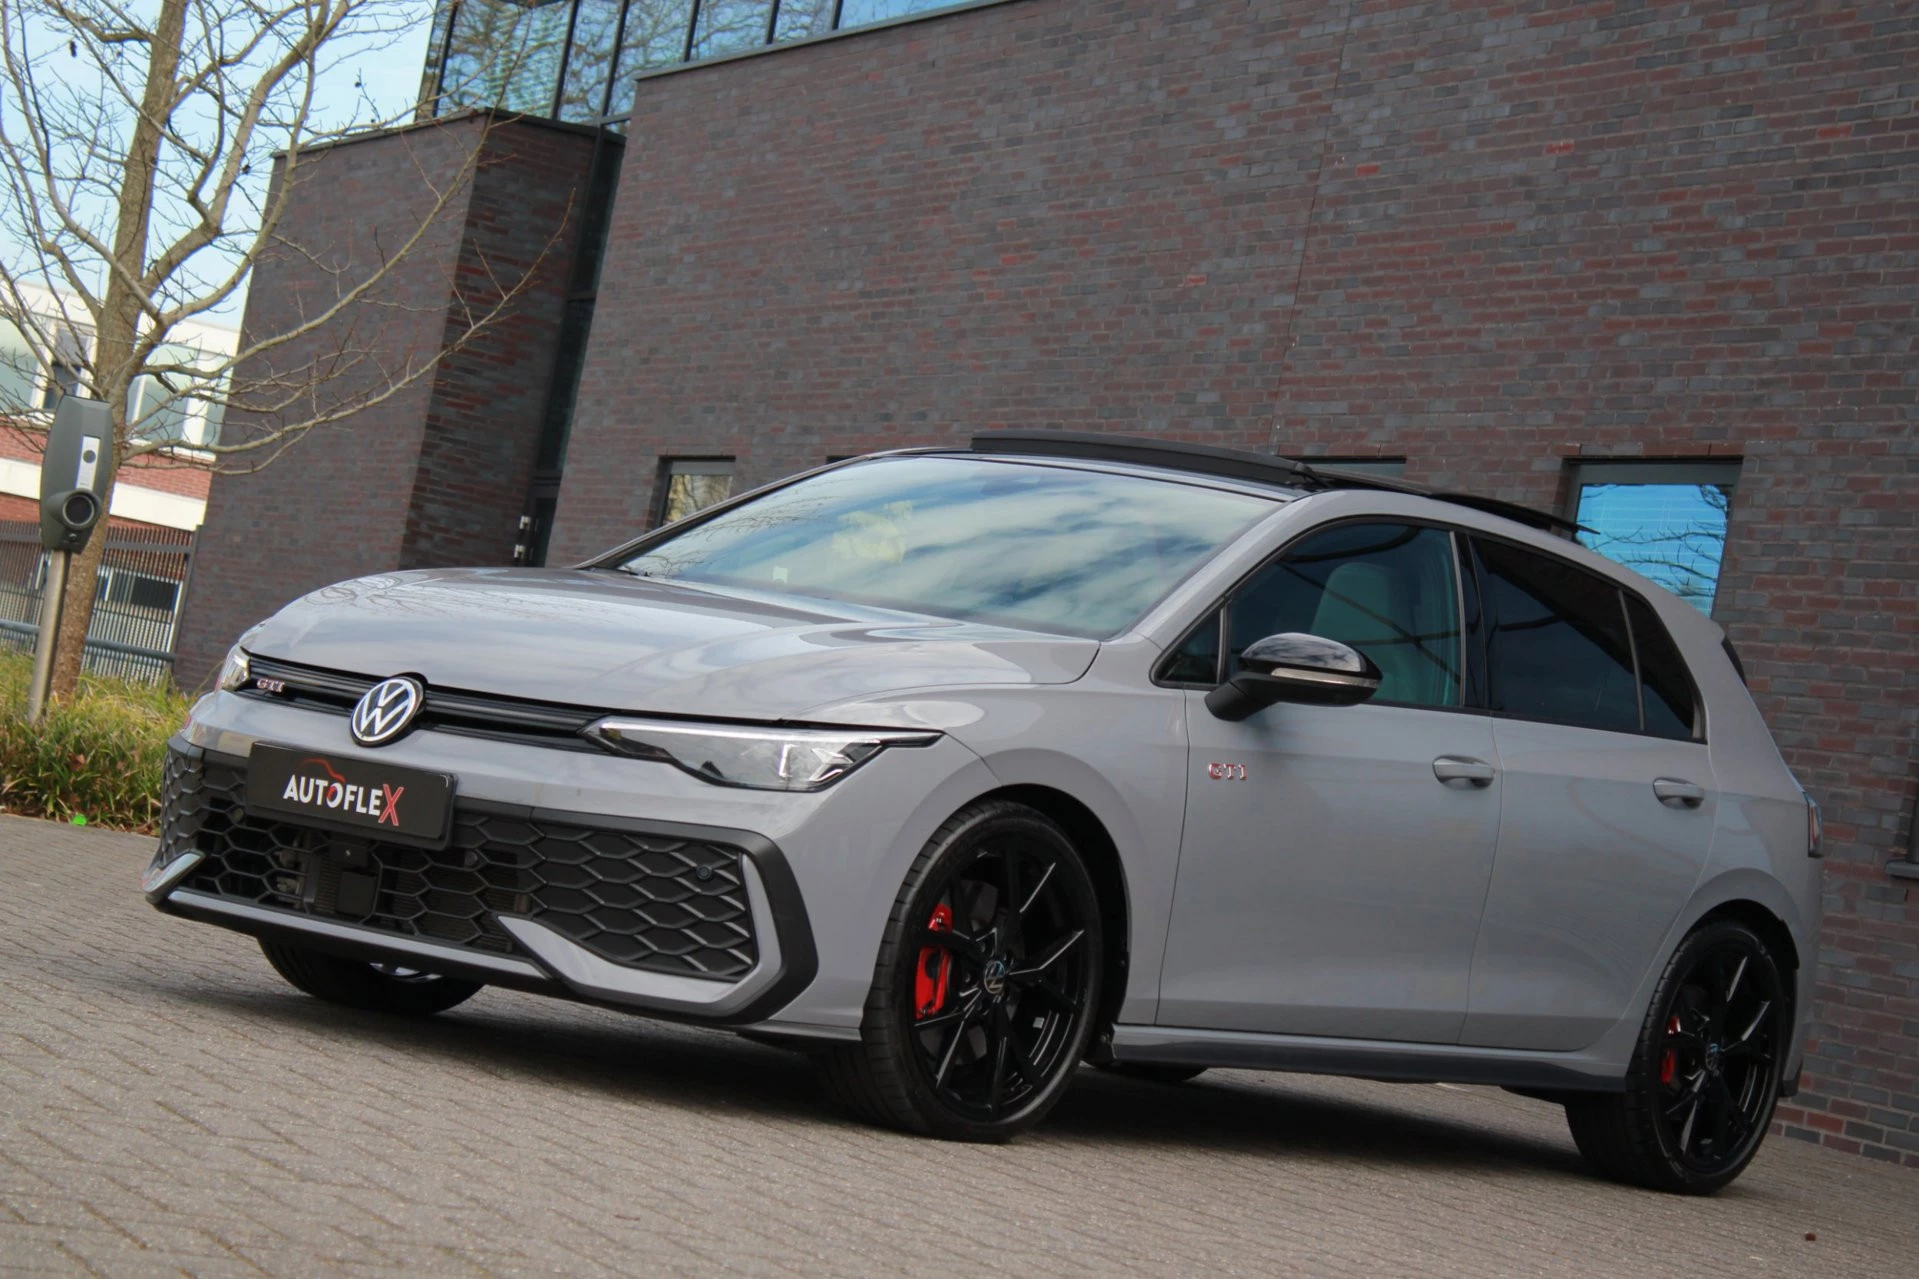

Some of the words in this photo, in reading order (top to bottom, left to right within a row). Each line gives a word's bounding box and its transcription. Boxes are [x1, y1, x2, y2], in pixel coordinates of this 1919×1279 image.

[256, 678, 285, 692] GTI
[355, 679, 416, 740] VW
[1208, 763, 1247, 780] GTI
[283, 774, 404, 826] AUTOFLEX
